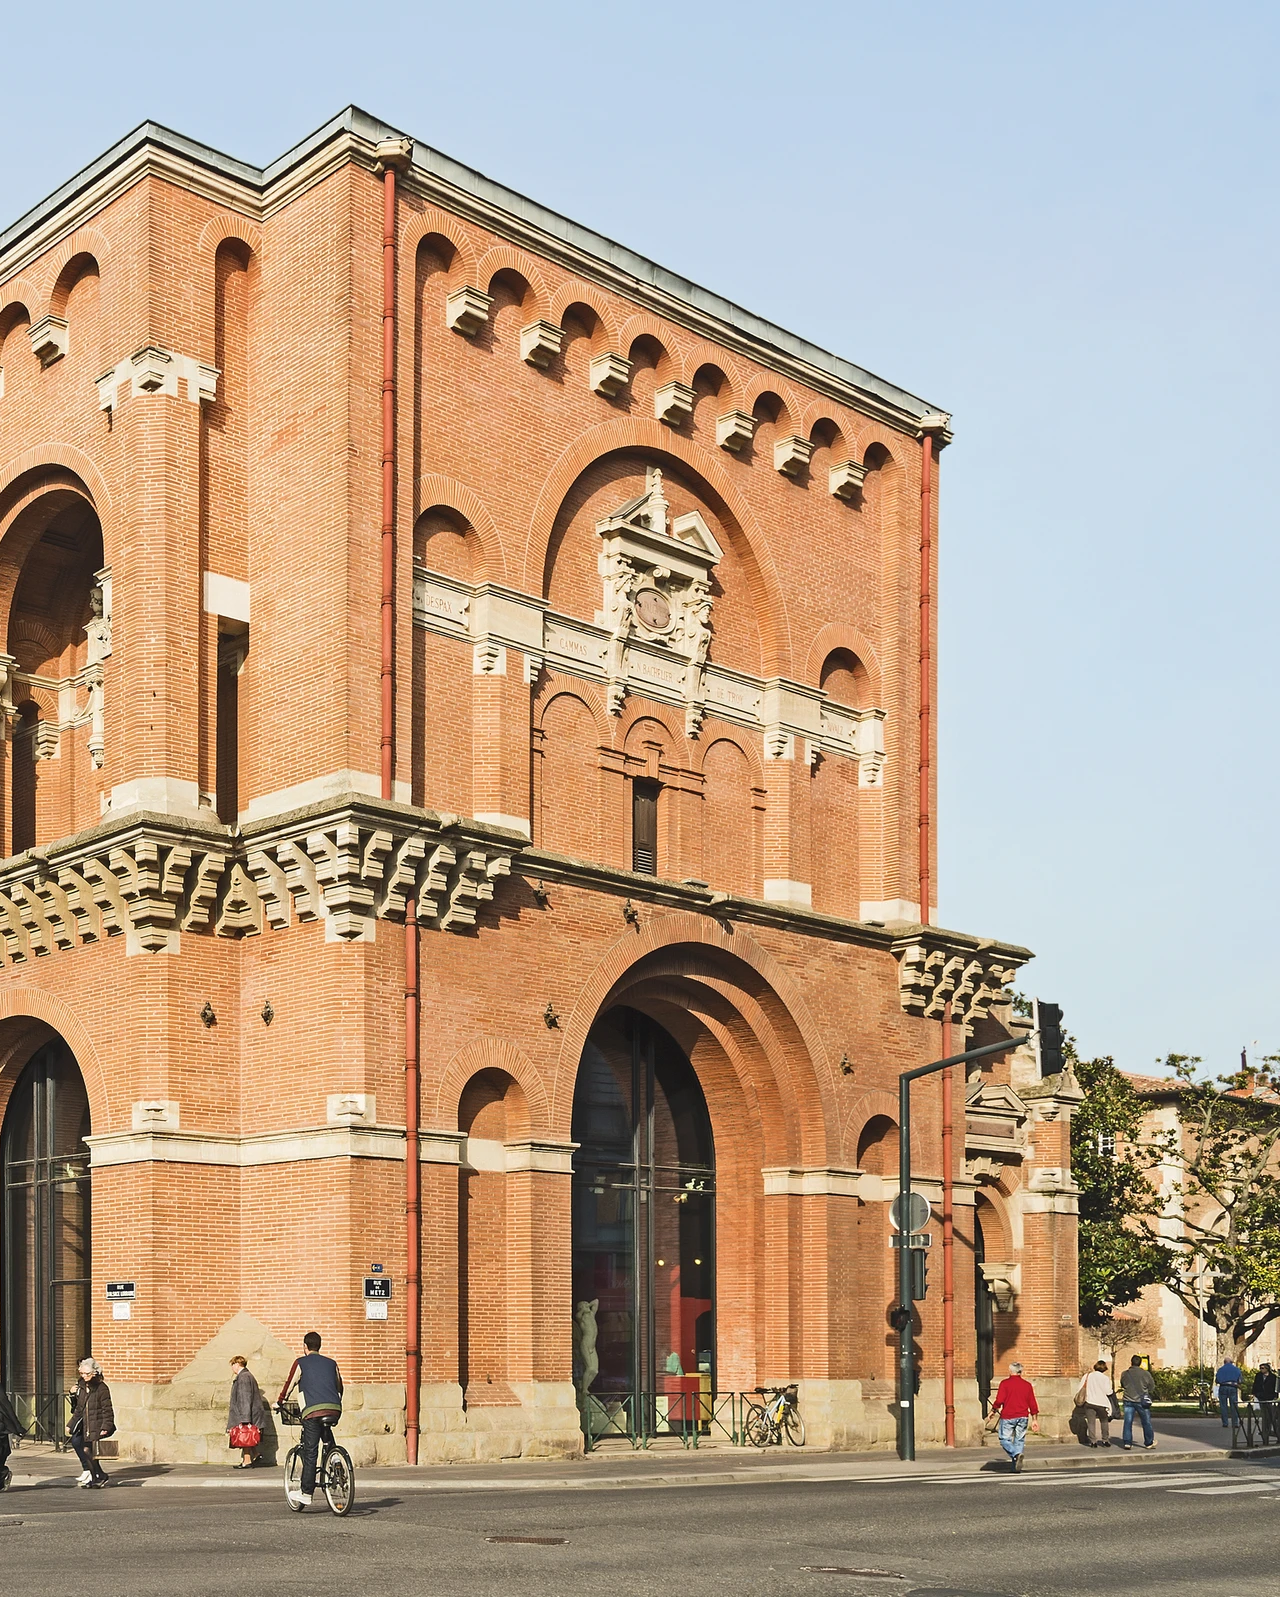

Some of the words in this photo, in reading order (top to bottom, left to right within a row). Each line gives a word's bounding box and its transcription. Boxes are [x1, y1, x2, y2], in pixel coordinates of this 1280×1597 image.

[425, 592, 452, 614] DESPAX
[559, 637, 588, 656] CAMMAS
[643, 663, 673, 682] BACHELIER
[728, 690, 744, 704] TROY
